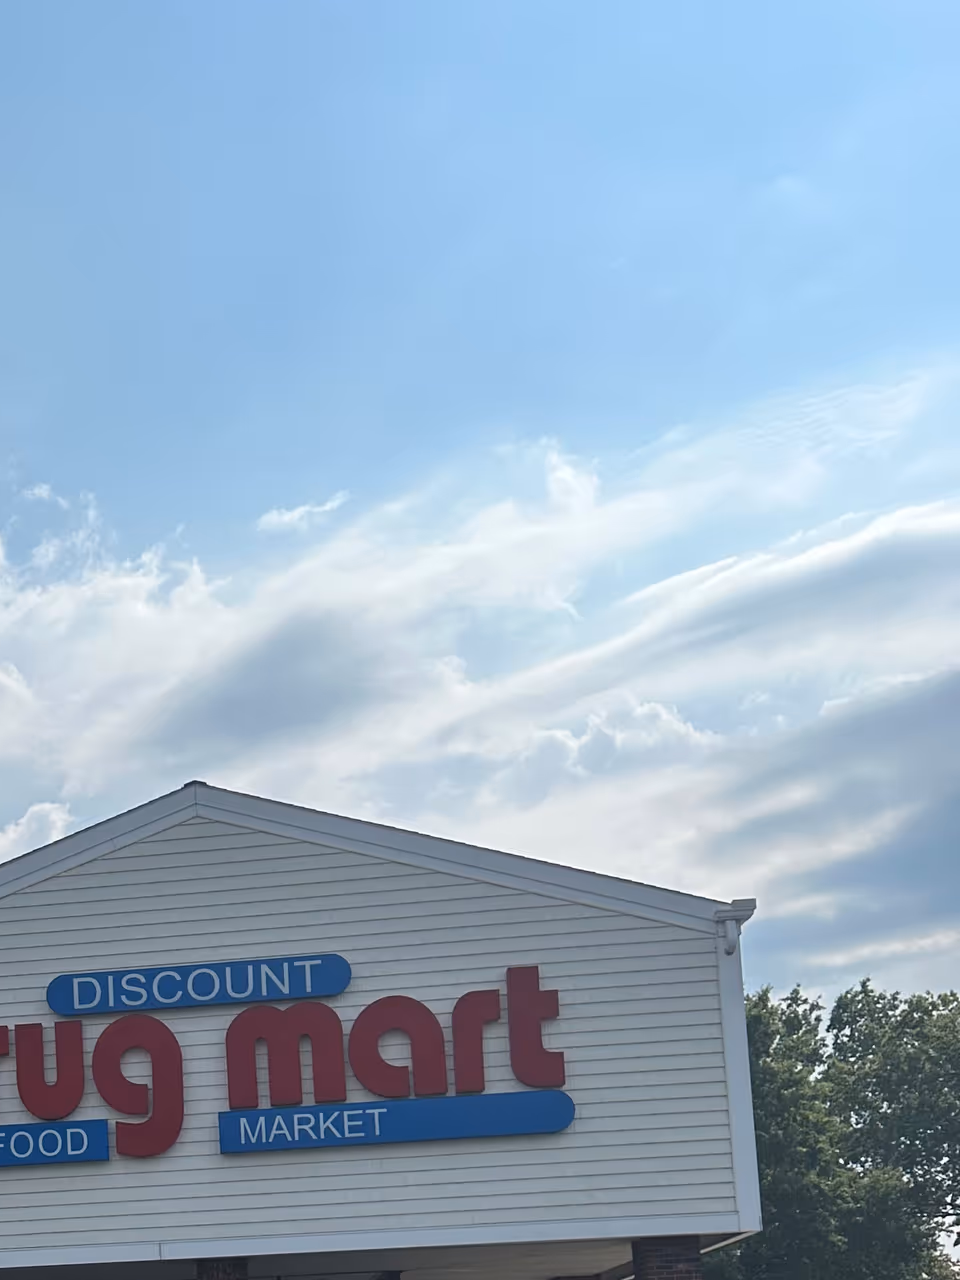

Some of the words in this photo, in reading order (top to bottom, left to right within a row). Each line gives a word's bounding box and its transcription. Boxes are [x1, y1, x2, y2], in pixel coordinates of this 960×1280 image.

[71, 958, 323, 1012] DISCOUNT
[225, 964, 567, 1110] mart
[239, 1107, 388, 1144] MARKET
